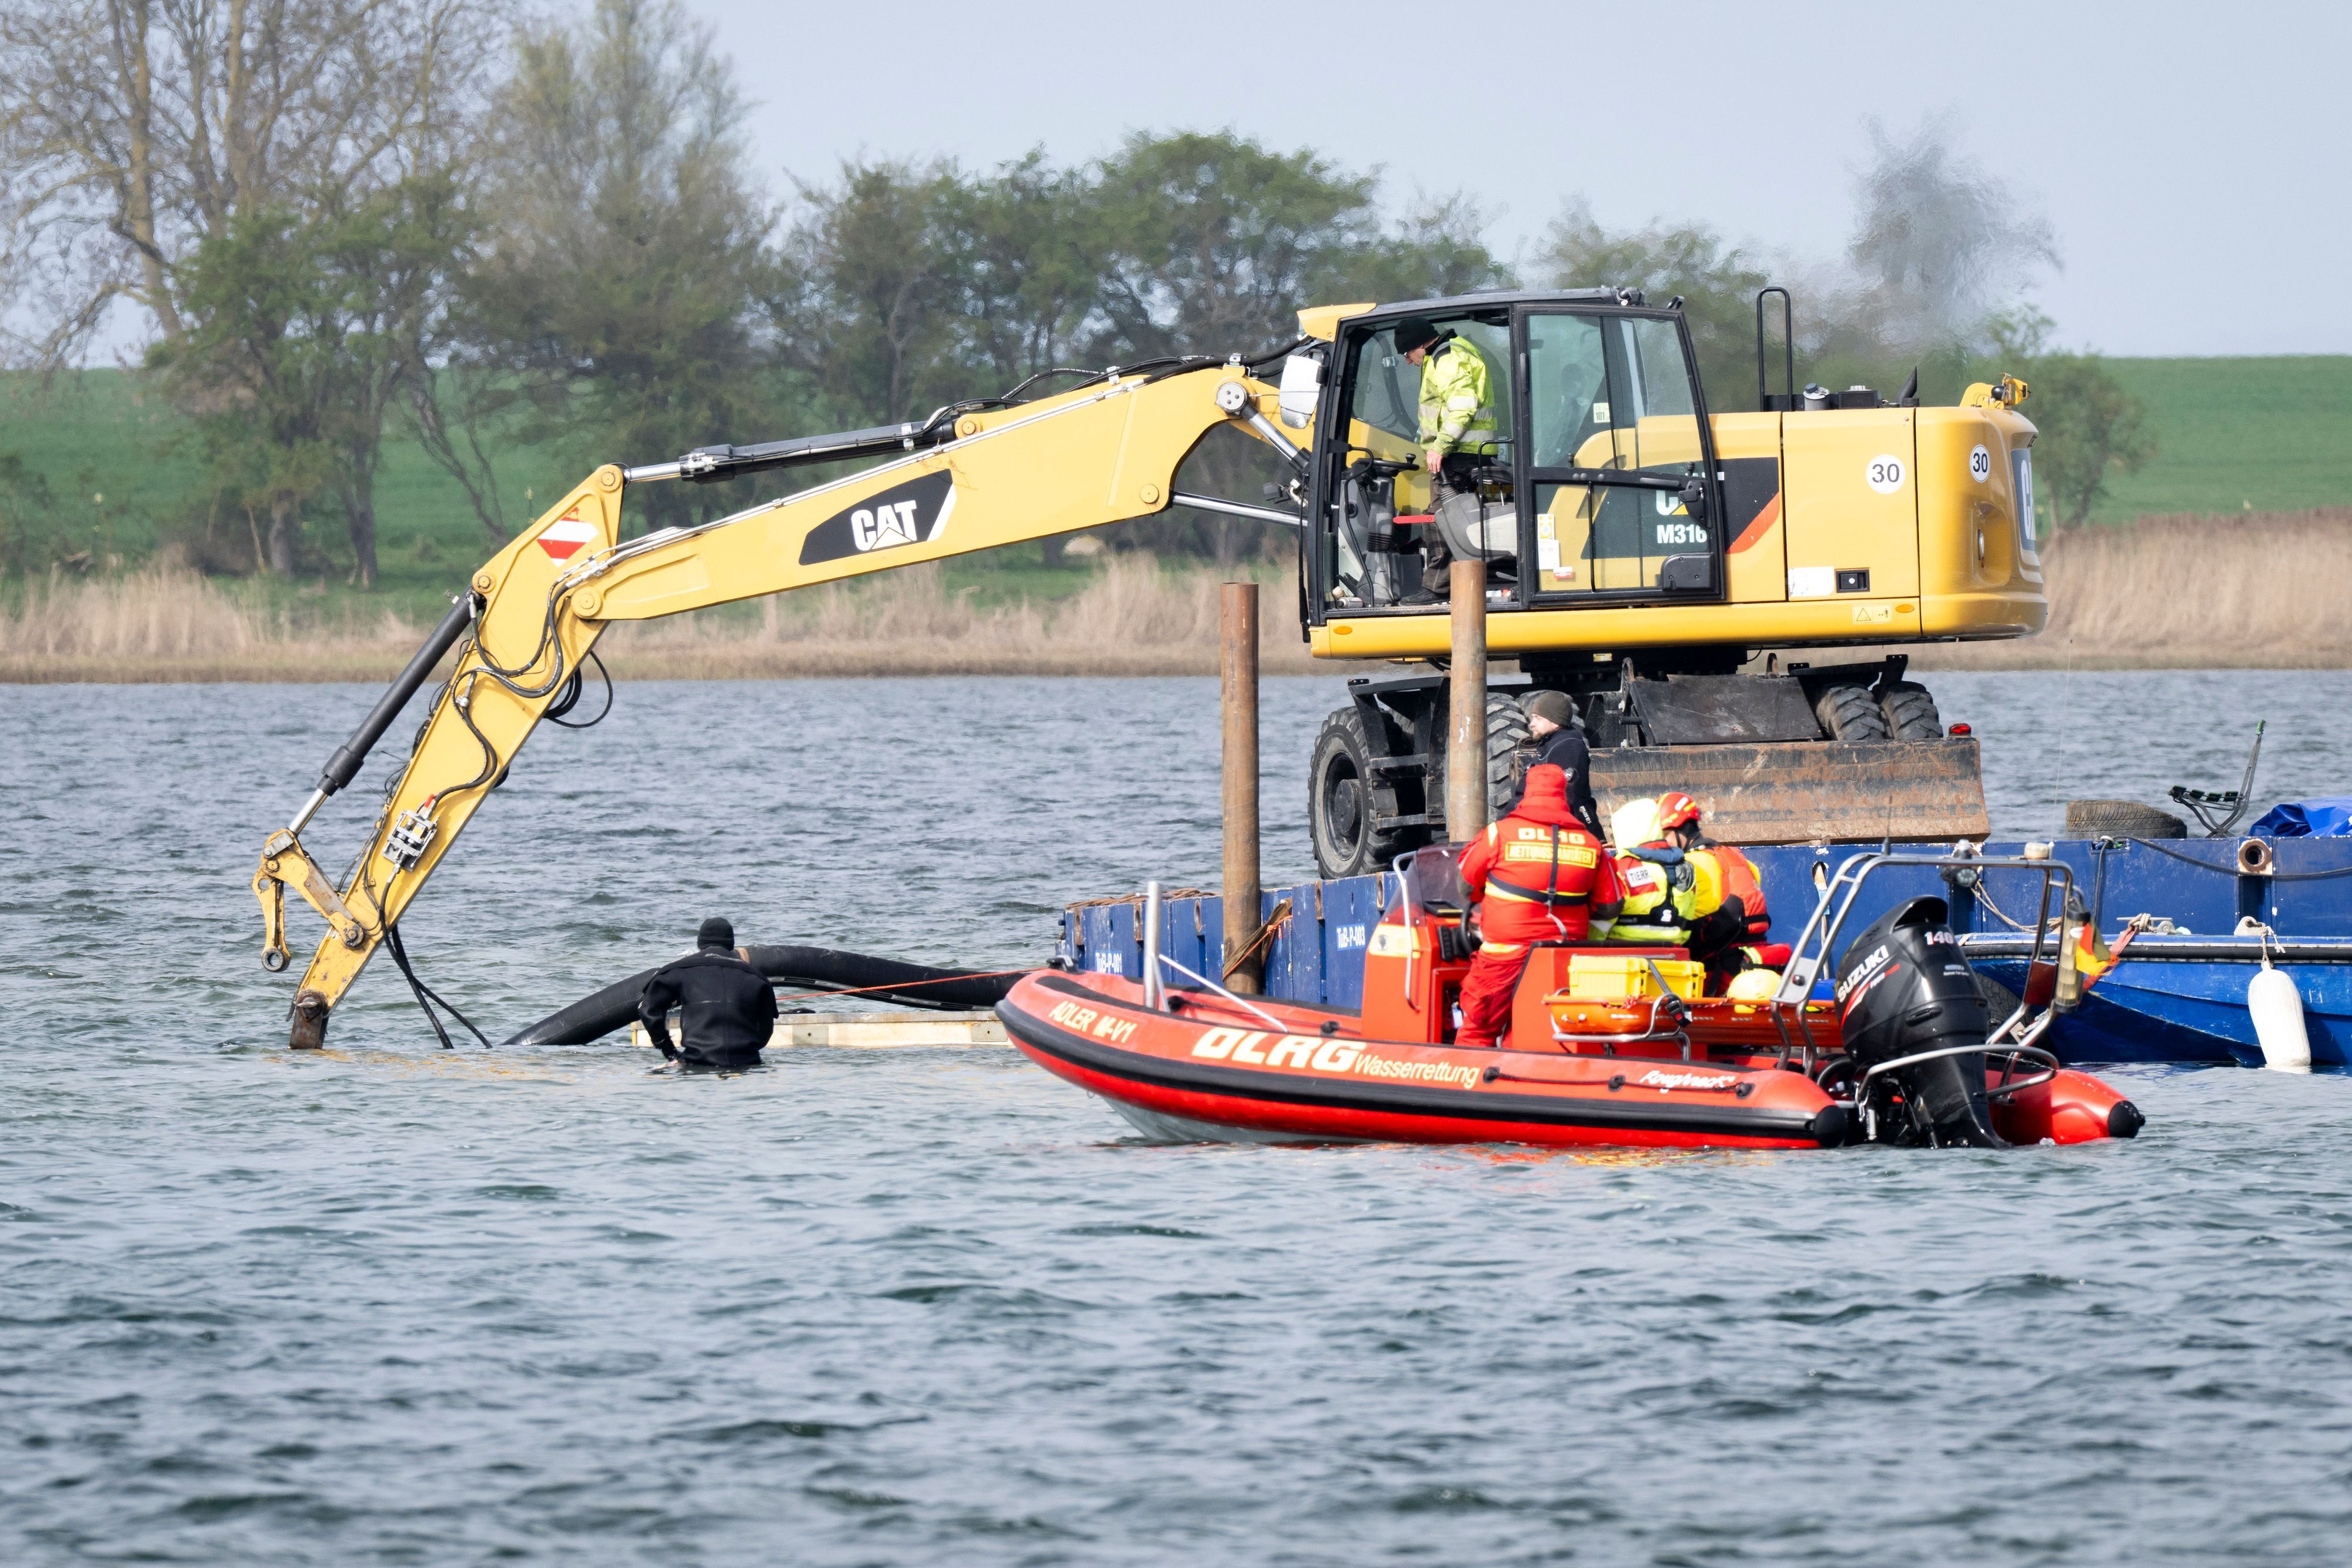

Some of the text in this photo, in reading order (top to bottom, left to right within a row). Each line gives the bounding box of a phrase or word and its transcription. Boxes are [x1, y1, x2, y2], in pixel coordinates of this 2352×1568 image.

[1872, 463, 1900, 483] 30
[1973, 453, 1988, 473] 30
[851, 500, 917, 551] CAT
[1657, 524, 1708, 544] M316
[1337, 925, 1365, 948] TuB-P-003
[1924, 931, 1954, 945] 140
[1838, 945, 1889, 1002] SUZUKI
[1048, 1001, 1098, 1032] ADLER
[1192, 1027, 1479, 1089] DLRG Wasserrettung
